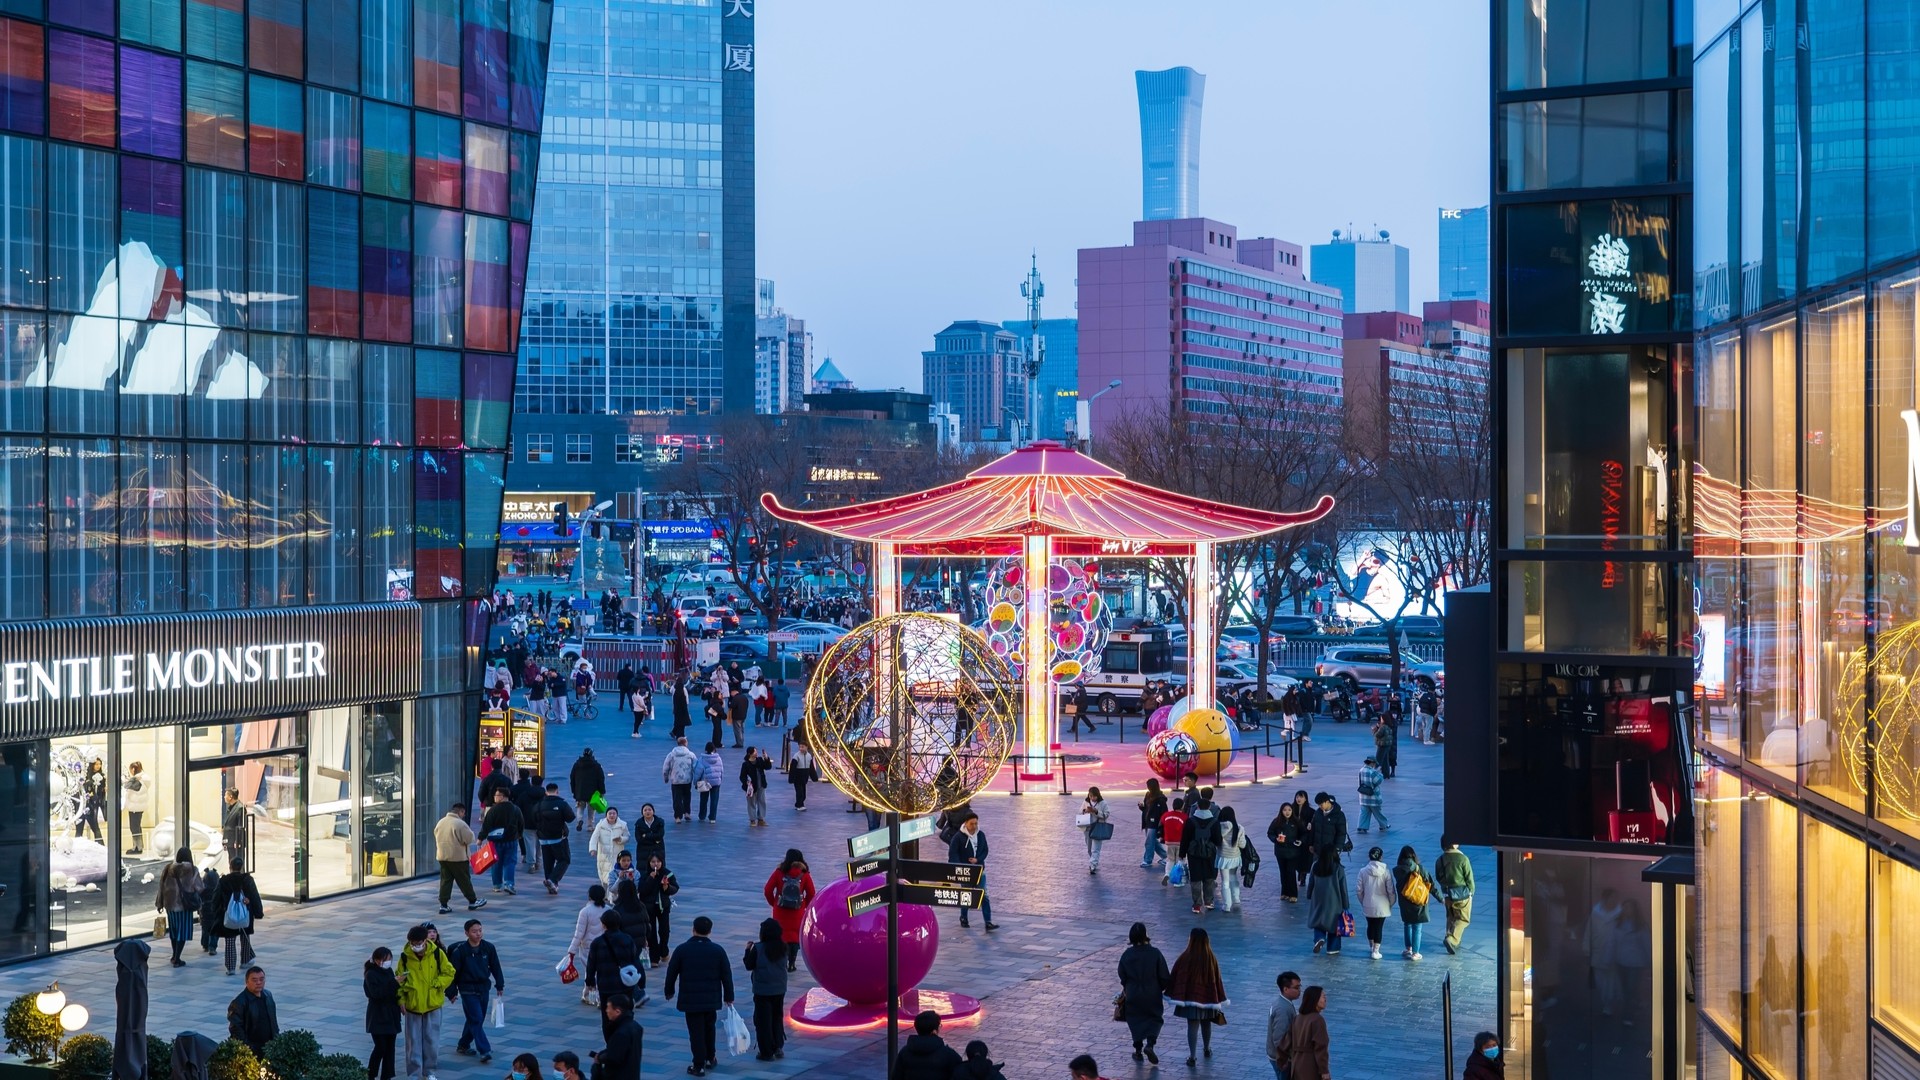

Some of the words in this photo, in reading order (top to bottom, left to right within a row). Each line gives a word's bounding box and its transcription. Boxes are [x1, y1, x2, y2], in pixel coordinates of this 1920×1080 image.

[724, 0, 754, 72] 大厦
[1442, 210, 1462, 219] FFC
[504, 512, 538, 520] ZHONG
[539, 512, 552, 520] YU
[671, 526, 684, 534] SPD
[0, 655, 135, 704] ENTLE
[147, 641, 327, 692] MONSTER
[1105, 674, 1129, 684] 警察
[955, 866, 971, 876] 西区
[934, 889, 959, 900] 地铁站
